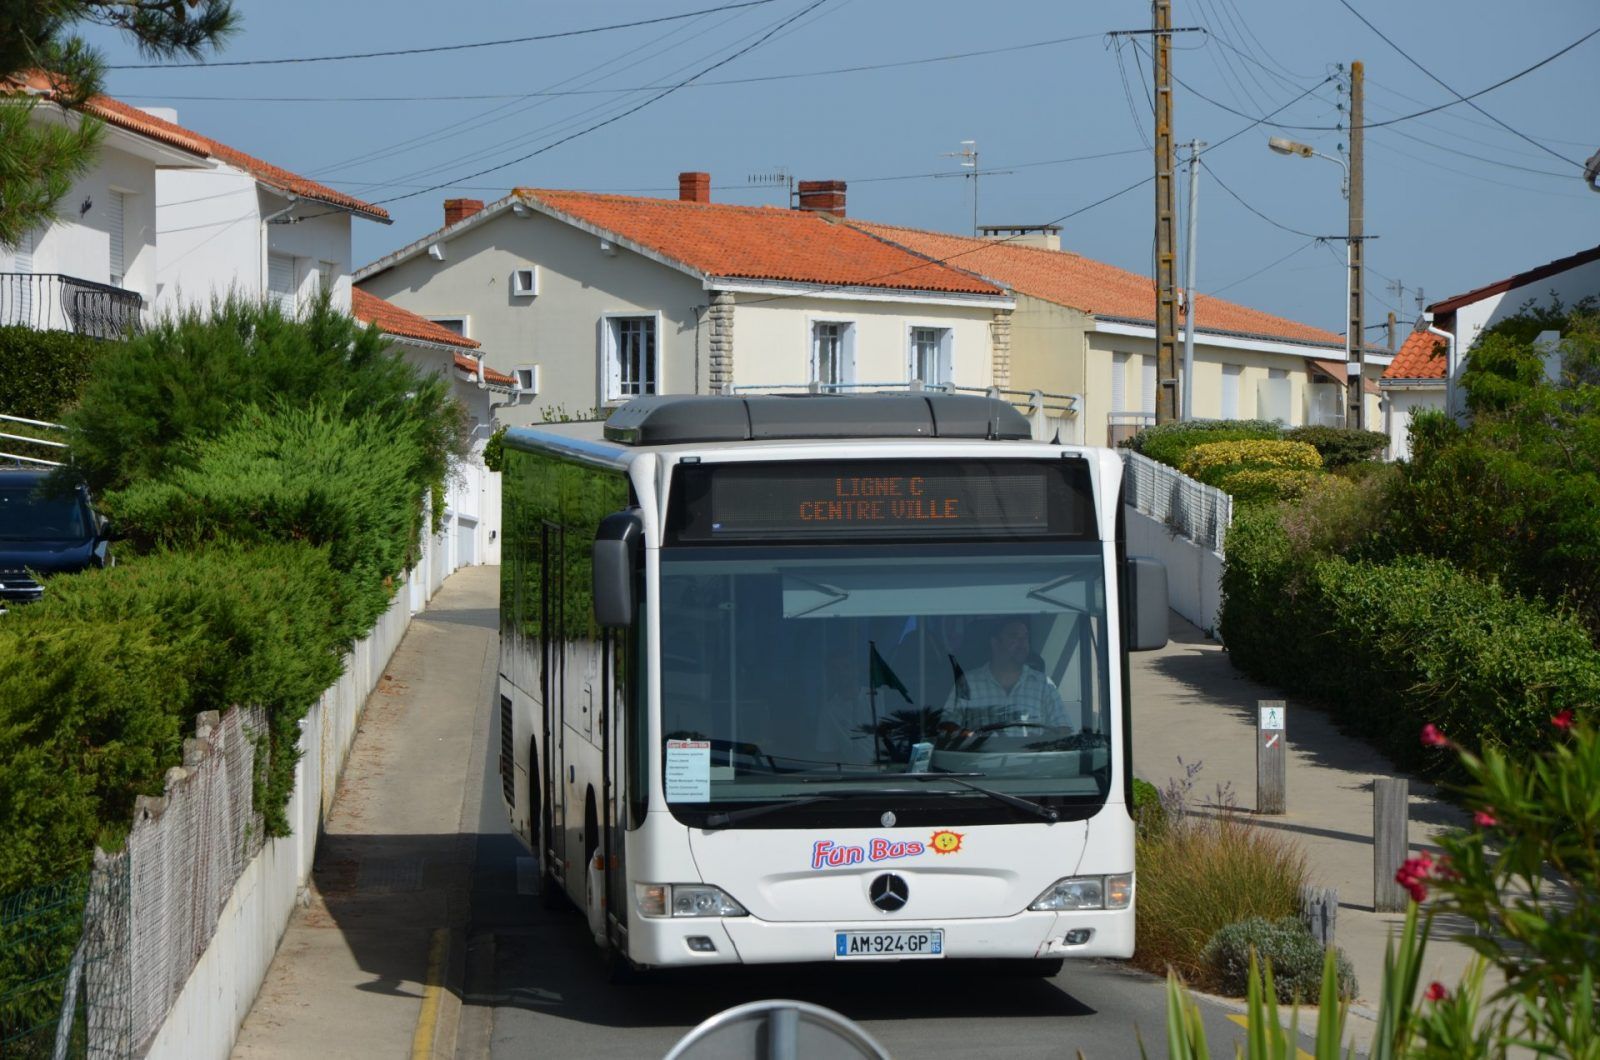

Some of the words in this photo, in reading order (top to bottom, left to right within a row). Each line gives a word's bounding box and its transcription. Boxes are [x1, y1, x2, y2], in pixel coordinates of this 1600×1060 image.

[836, 477, 903, 496] LIGNE
[910, 477, 925, 496] C
[799, 501, 884, 521] CENTRE
[891, 498, 960, 519] VILLE
[812, 840, 864, 869] Fun
[869, 838, 925, 862] Bus
